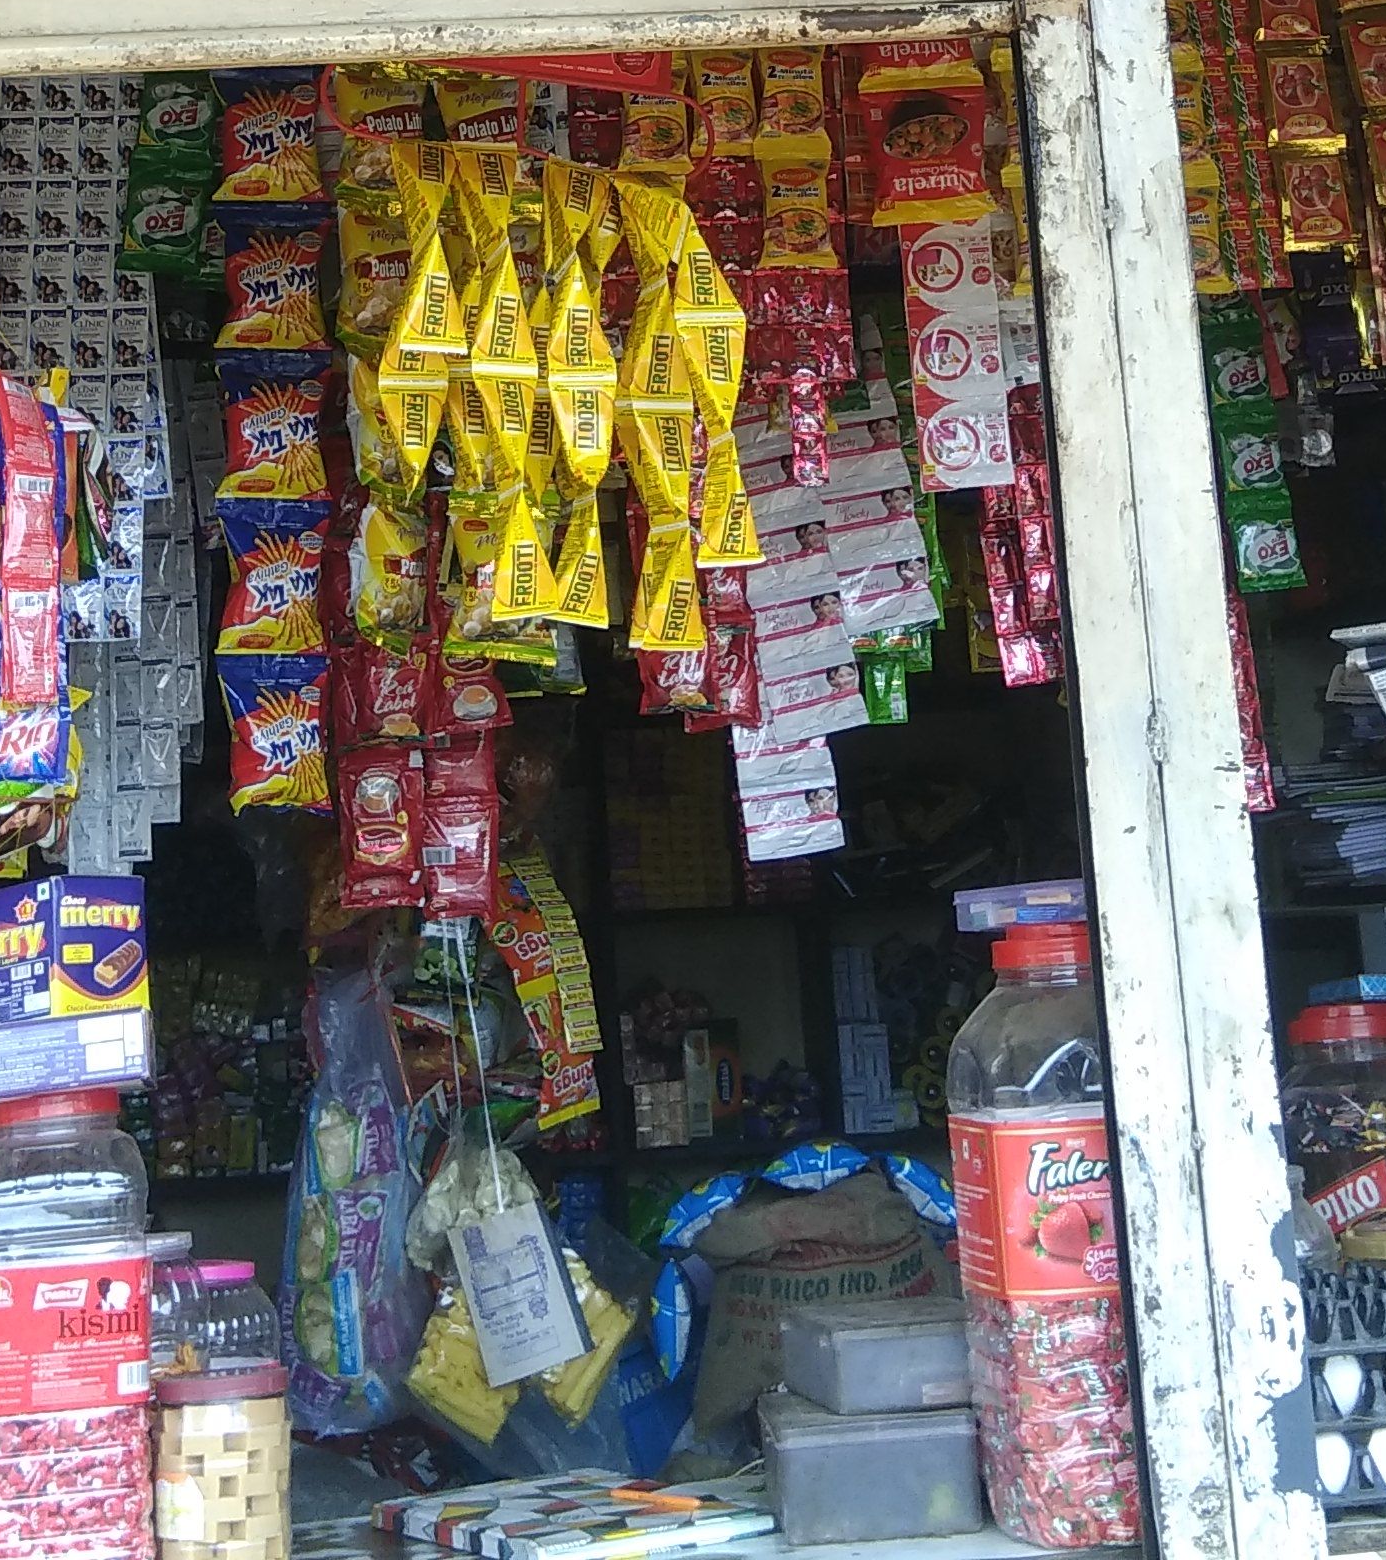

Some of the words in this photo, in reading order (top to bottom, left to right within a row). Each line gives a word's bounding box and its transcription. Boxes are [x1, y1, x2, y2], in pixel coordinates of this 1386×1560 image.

[879, 41, 961, 62] Nutrela
[366, 113, 404, 133] Potato
[459, 119, 499, 140] Potato
[893, 173, 978, 195] Nutrela
[145, 211, 185, 233] EXO
[371, 257, 406, 277] Potato
[696, 251, 714, 306] FROOTI
[424, 273, 449, 338] FROOTI
[492, 296, 517, 359] FROOTI
[570, 307, 591, 368] FROOTI
[648, 334, 671, 396] FROOTI
[708, 326, 729, 383] FROOTI
[1229, 366, 1260, 388] EXO
[404, 392, 424, 448] FROOTI
[501, 381, 525, 433] FROOTI
[577, 390, 595, 450] FROOTI
[662, 416, 685, 473] FROOTI
[1243, 453, 1274, 475] EXO
[723, 491, 747, 556] FROOTI
[1257, 541, 1289, 561] EXO
[248, 560, 289, 584] Gathiya
[514, 543, 536, 607] FROOTI
[565, 552, 598, 614] FROOTI
[665, 580, 693, 642] FROOTI
[374, 696, 417, 715] Label
[59, 902, 142, 932] merry
[60, 895, 87, 907] Choco
[553, 1060, 595, 1097] Rings
[1048, 1192, 1069, 1204] Pulpy
[1070, 1191, 1088, 1202] Fruit
[59, 1303, 140, 1339] kismi
